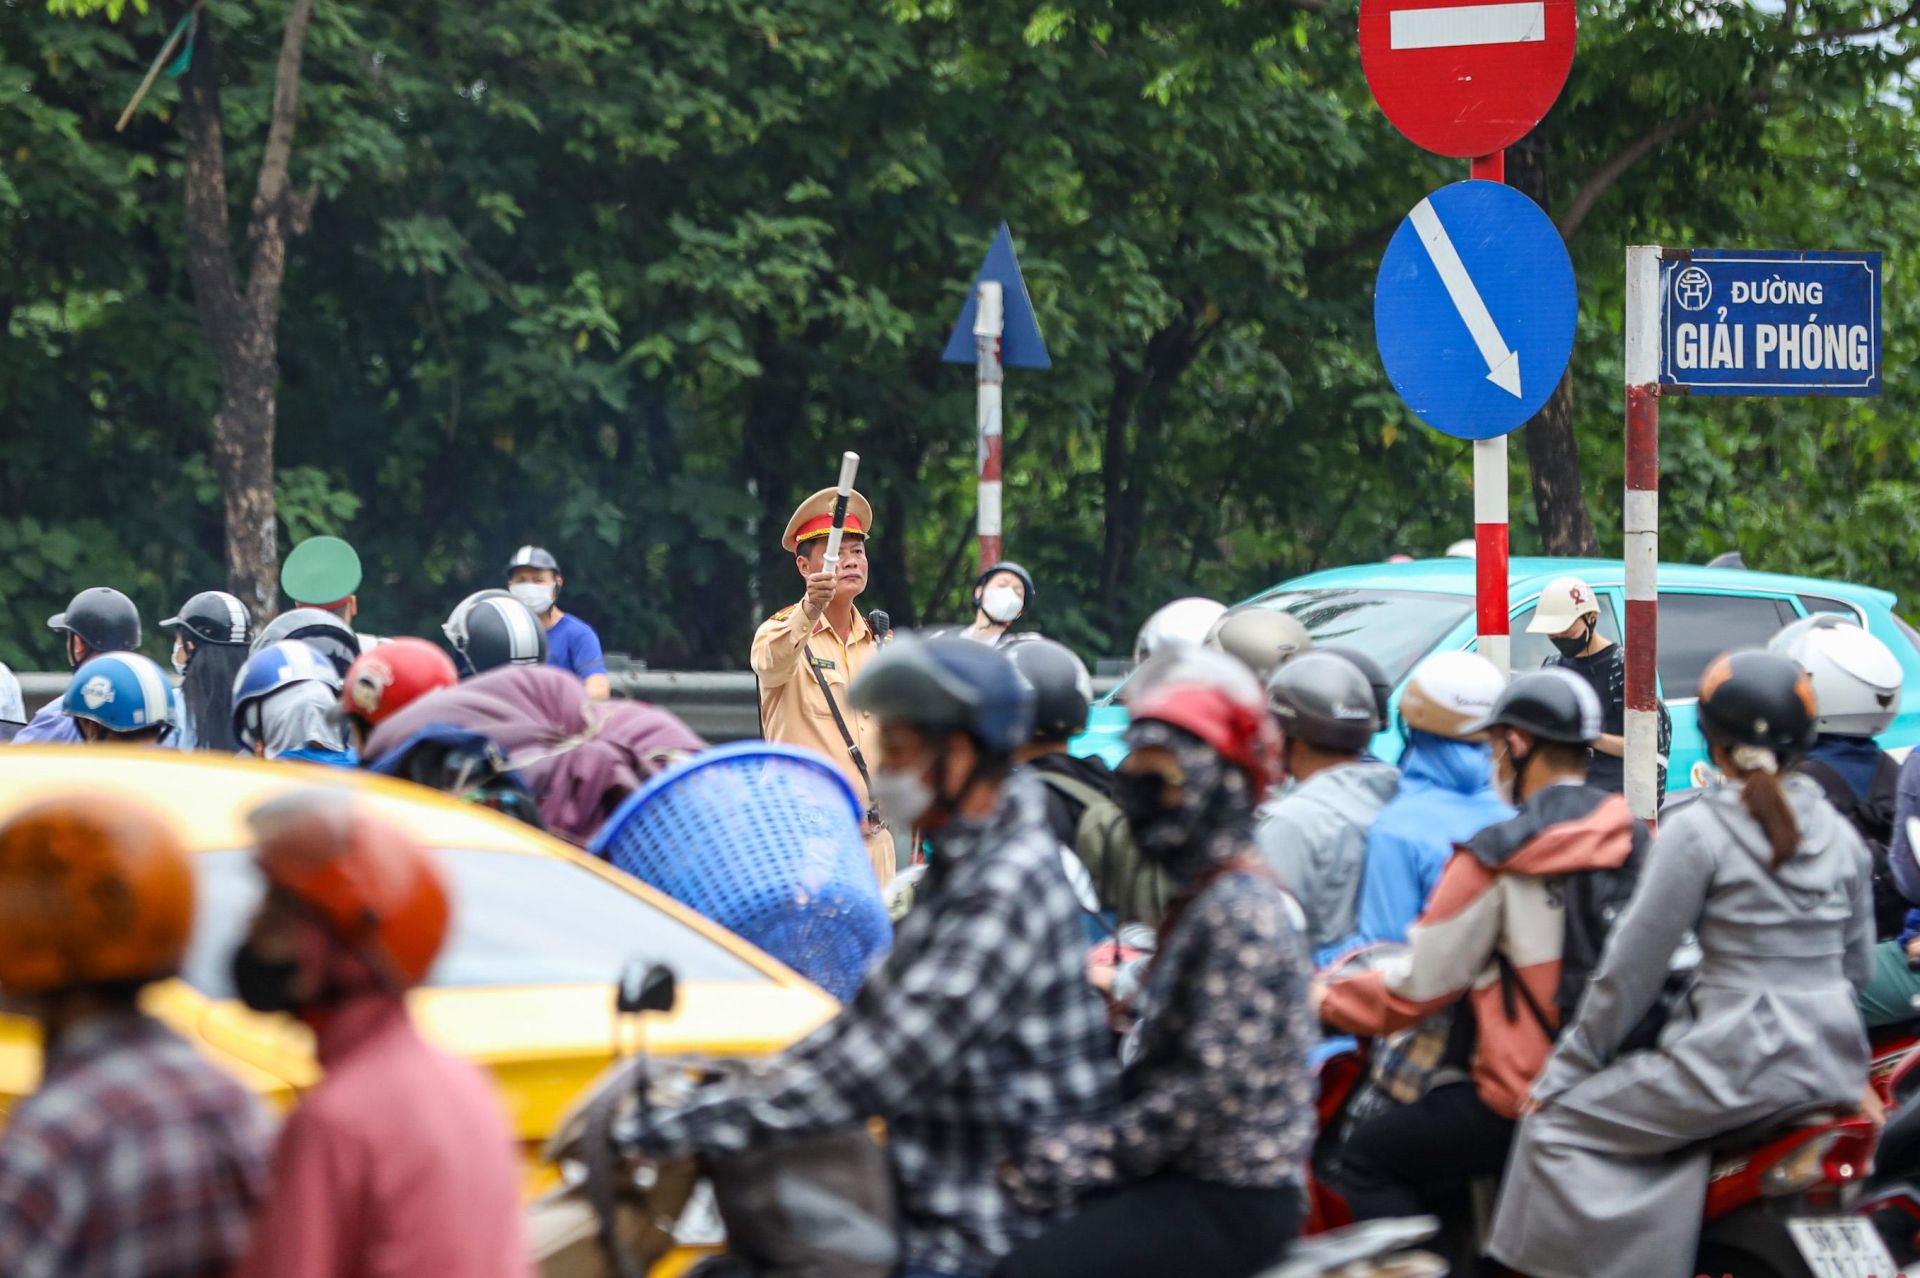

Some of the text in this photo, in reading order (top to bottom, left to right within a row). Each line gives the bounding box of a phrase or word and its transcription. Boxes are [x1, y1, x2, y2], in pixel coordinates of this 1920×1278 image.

[1731, 274, 1823, 304] ĐƯỜNG
[1676, 306, 1868, 371] GIẢI PHÓNG
